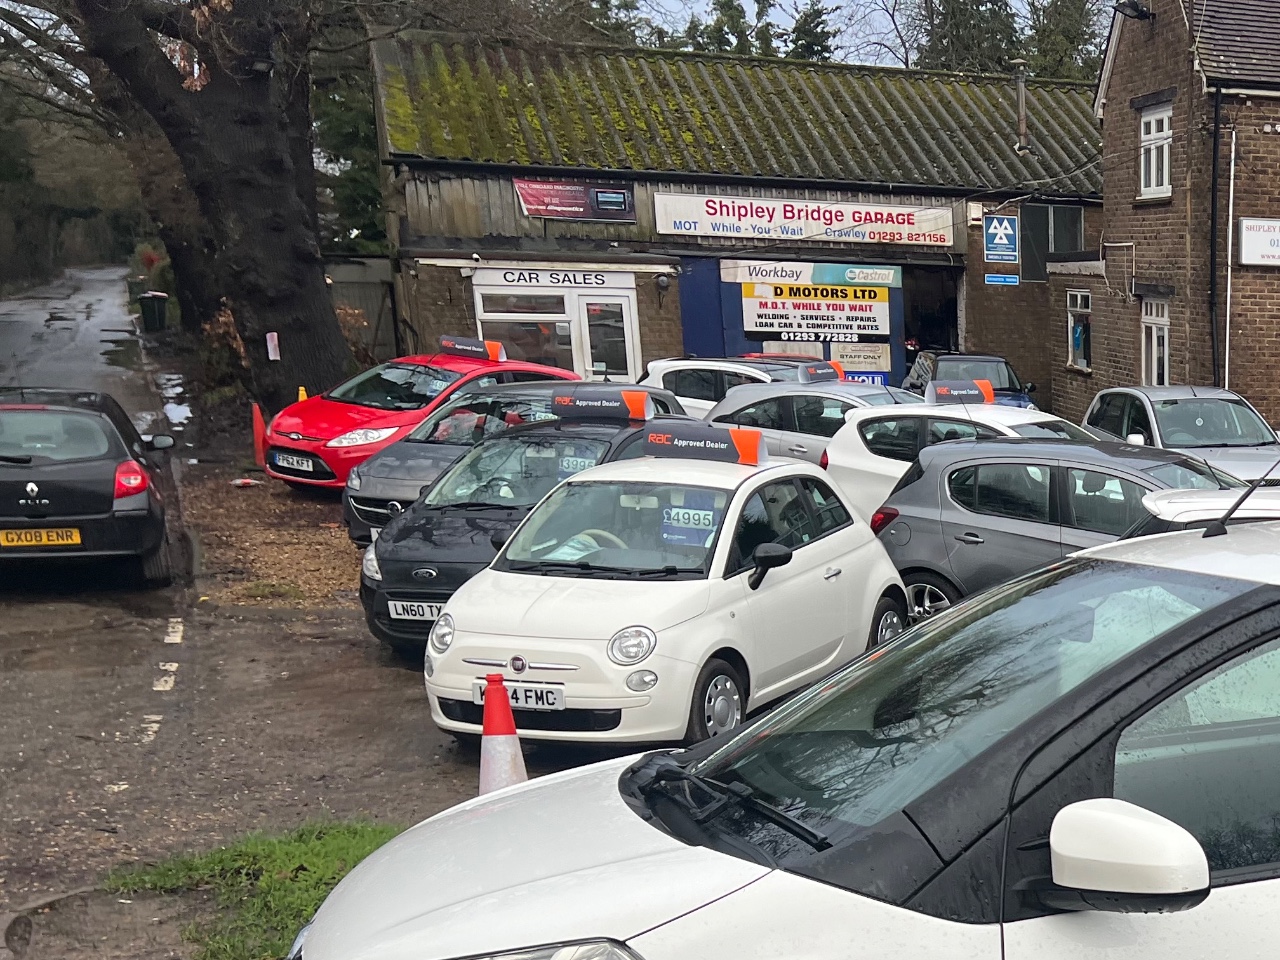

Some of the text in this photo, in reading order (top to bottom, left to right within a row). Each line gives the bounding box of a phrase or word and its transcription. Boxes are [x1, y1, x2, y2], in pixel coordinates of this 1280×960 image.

[705, 199, 915, 225] Shipley Bridge GARAGE
[673, 220, 699, 231] MOT
[711, 222, 741, 233] While
[750, 224, 771, 235] You
[780, 225, 804, 236] Wait
[825, 227, 946, 243] Crawley 01293 821156
[1245, 225, 1277, 233] SHIPLEY
[504, 271, 606, 285] CAR SALES
[748, 265, 892, 282] Workbay Castrol
[774, 286, 878, 300] D MOTORS LTD
[759, 301, 874, 313] M.O.T. WHILE YOU WAIT
[800, 314, 836, 322] SERVICES
[781, 332, 859, 342] 01293 772828
[576, 399, 601, 407] Approved
[673, 438, 704, 447] Approved
[706, 440, 728, 449] Dealer
[5, 530, 74, 543] GX08 ENR
[393, 602, 425, 617] LN60
[524, 689, 556, 706] FMC
